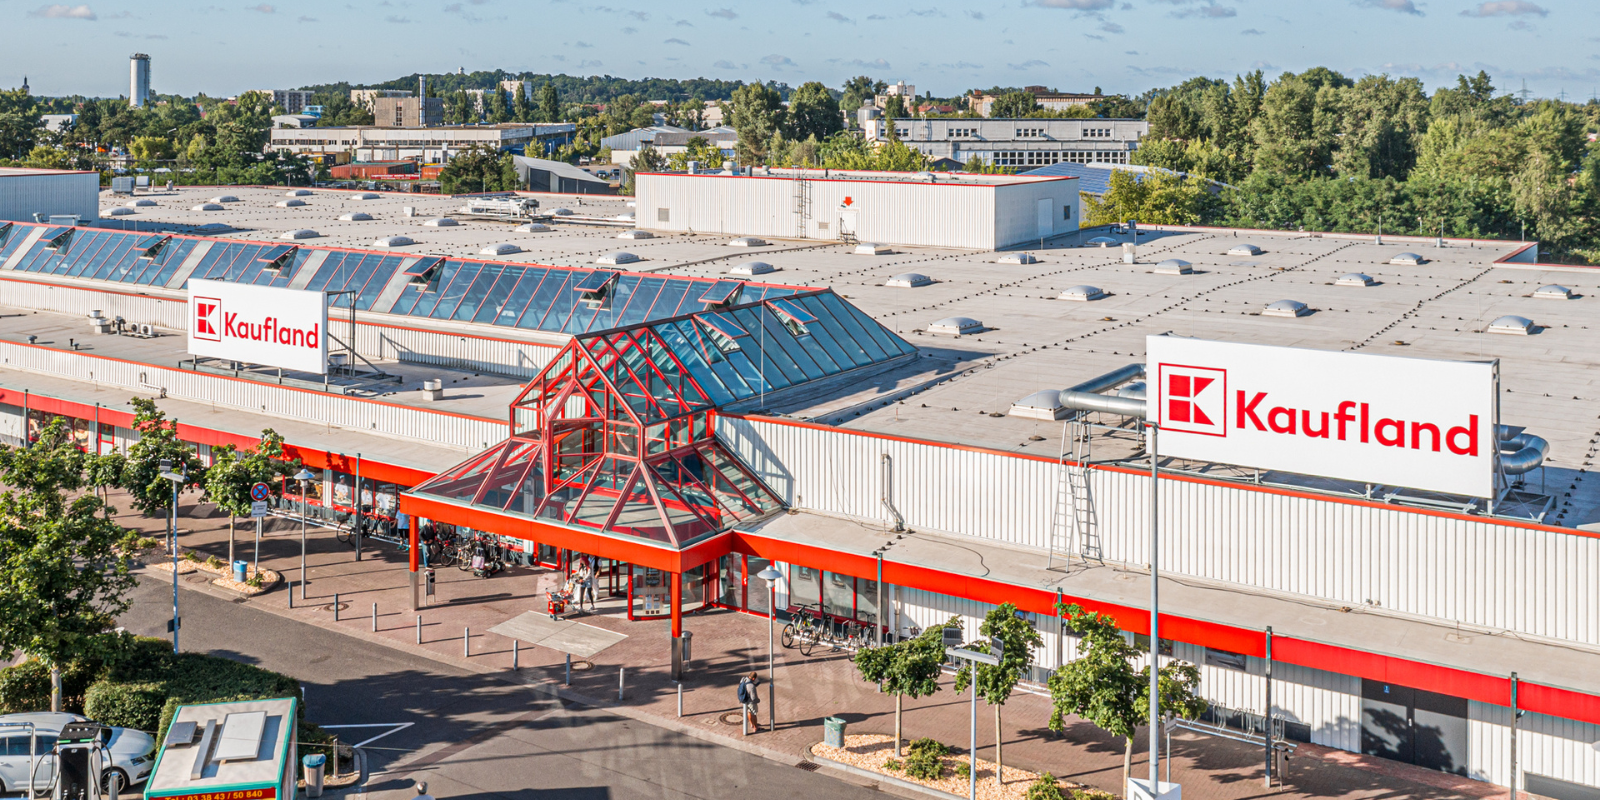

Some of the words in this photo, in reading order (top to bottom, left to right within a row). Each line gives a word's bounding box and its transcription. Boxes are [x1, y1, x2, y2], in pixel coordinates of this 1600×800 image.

[225, 311, 319, 349] Kaufland
[1236, 389, 1479, 457] Kaufland
[233, 791, 244, 799] 50
[246, 790, 263, 798] 840
